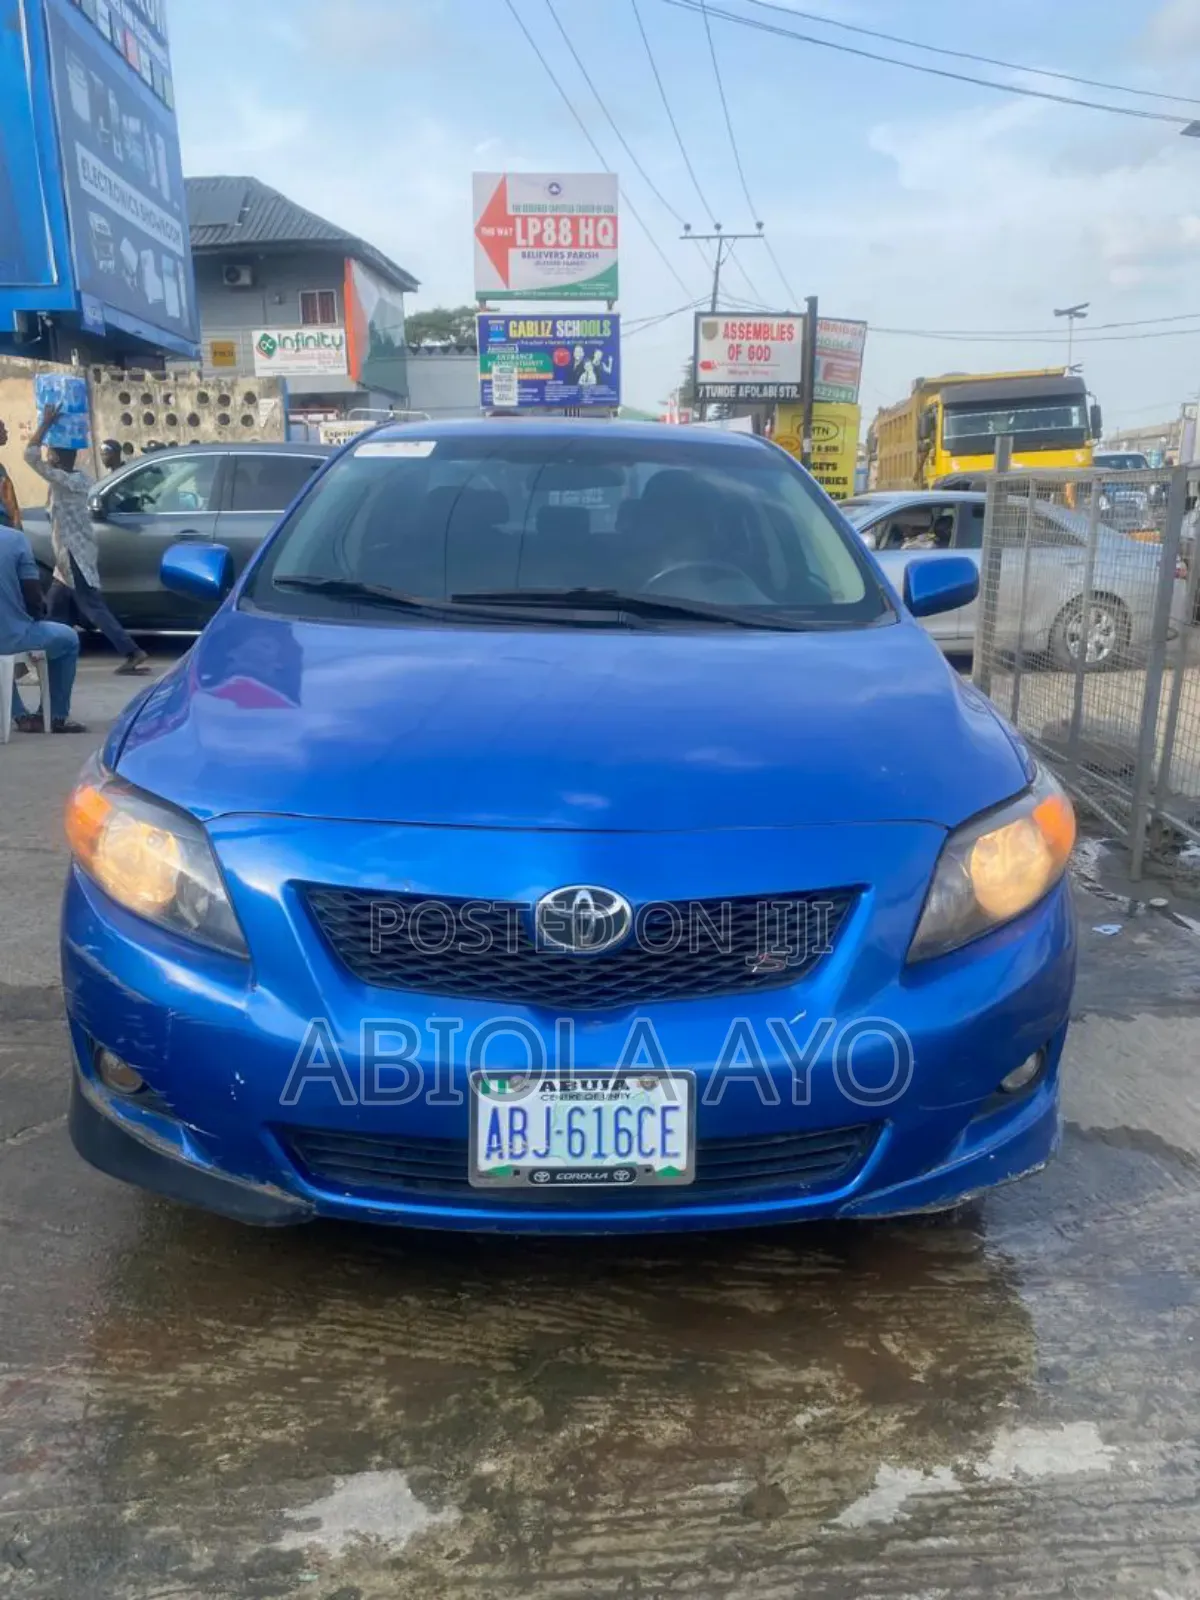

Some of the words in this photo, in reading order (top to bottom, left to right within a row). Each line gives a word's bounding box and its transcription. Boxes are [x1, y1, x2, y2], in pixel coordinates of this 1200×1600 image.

[497, 227, 513, 237] WAY
[514, 217, 573, 247] LP88
[578, 217, 615, 247] HQ
[521, 251, 565, 259] BELIEVERS
[567, 251, 599, 259] PARISH
[508, 320, 553, 338] GABLIZ
[556, 319, 612, 337] SCHOOLS
[722, 321, 795, 341] ASSEMBLIES
[727, 344, 742, 361] OF
[748, 346, 771, 362] GOD
[705, 385, 736, 398] TUNDE
[738, 385, 777, 398] AFOLABI
[779, 385, 800, 398] STR.
[811, 462, 837, 471] GETS
[539, 1080, 630, 1092] ABUJA
[485, 1106, 680, 1160] ABJ-616CE
[556, 1172, 608, 1180] COROLLA
